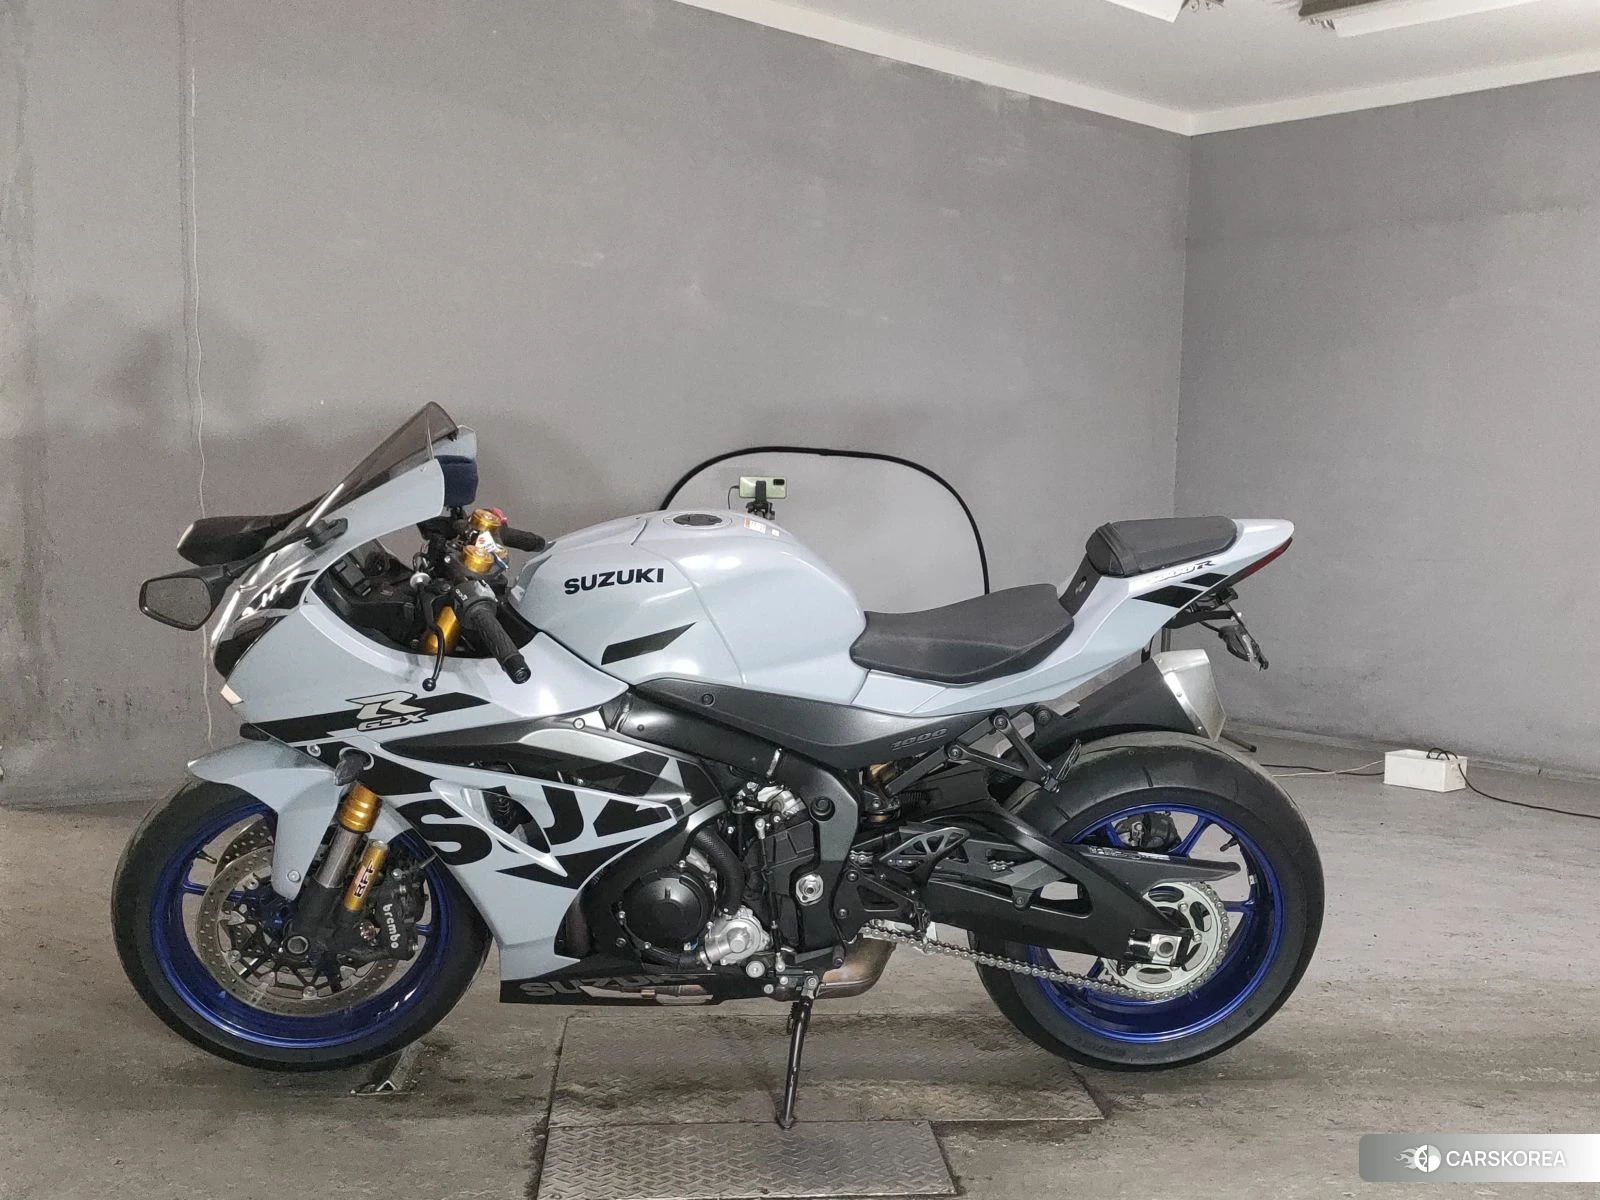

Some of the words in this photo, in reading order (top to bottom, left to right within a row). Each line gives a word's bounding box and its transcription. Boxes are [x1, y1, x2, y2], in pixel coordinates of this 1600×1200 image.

[564, 568, 664, 595] SUZUKI
[356, 710, 429, 732] GSX
[890, 728, 949, 751] 1000
[382, 903, 401, 949] brembo
